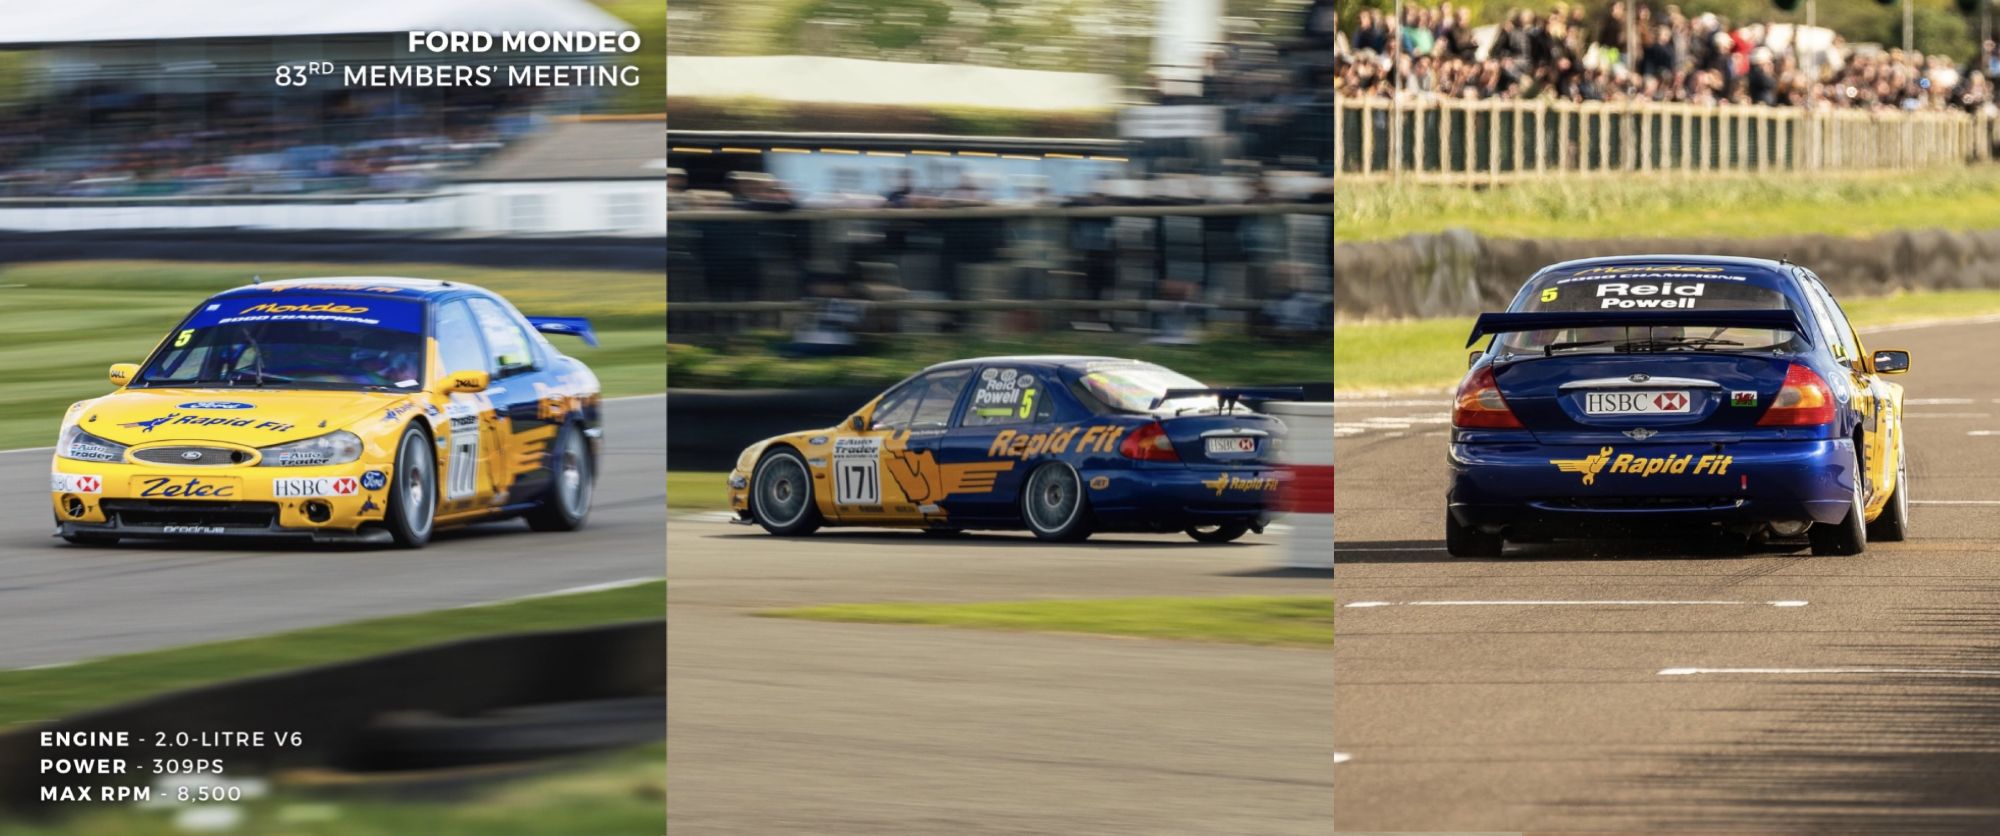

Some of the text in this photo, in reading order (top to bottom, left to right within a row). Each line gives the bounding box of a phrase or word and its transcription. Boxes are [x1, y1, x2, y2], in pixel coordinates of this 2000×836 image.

[1573, 265, 1725, 276] Mondeo
[1619, 272, 1747, 282] CHAMPIONS
[1540, 287, 1559, 303] 5
[1596, 282, 1705, 297] Reid
[239, 302, 370, 315] Mondeo
[1601, 297, 1696, 309] Powell
[270, 314, 380, 325] CHAMPIONS
[174, 328, 196, 348] 5
[986, 379, 1016, 390] Reid
[975, 388, 1020, 404] Powell
[1019, 388, 1037, 419] 5
[1588, 392, 1648, 412] HSBC
[172, 414, 295, 432] Rapid Fit
[835, 446, 879, 454] Trader
[987, 424, 1126, 461] Rapid Fit
[71, 450, 114, 460] Trader
[280, 458, 330, 466] Trader
[289, 451, 321, 459] Auto
[1609, 453, 1733, 477] Rapid Fit
[140, 477, 234, 498] Zetec
[275, 479, 329, 497] HSBC
[363, 471, 387, 489] Ford
[844, 465, 874, 500] 171
[1230, 476, 1264, 492] Rapid
[163, 525, 225, 534] prodrive
